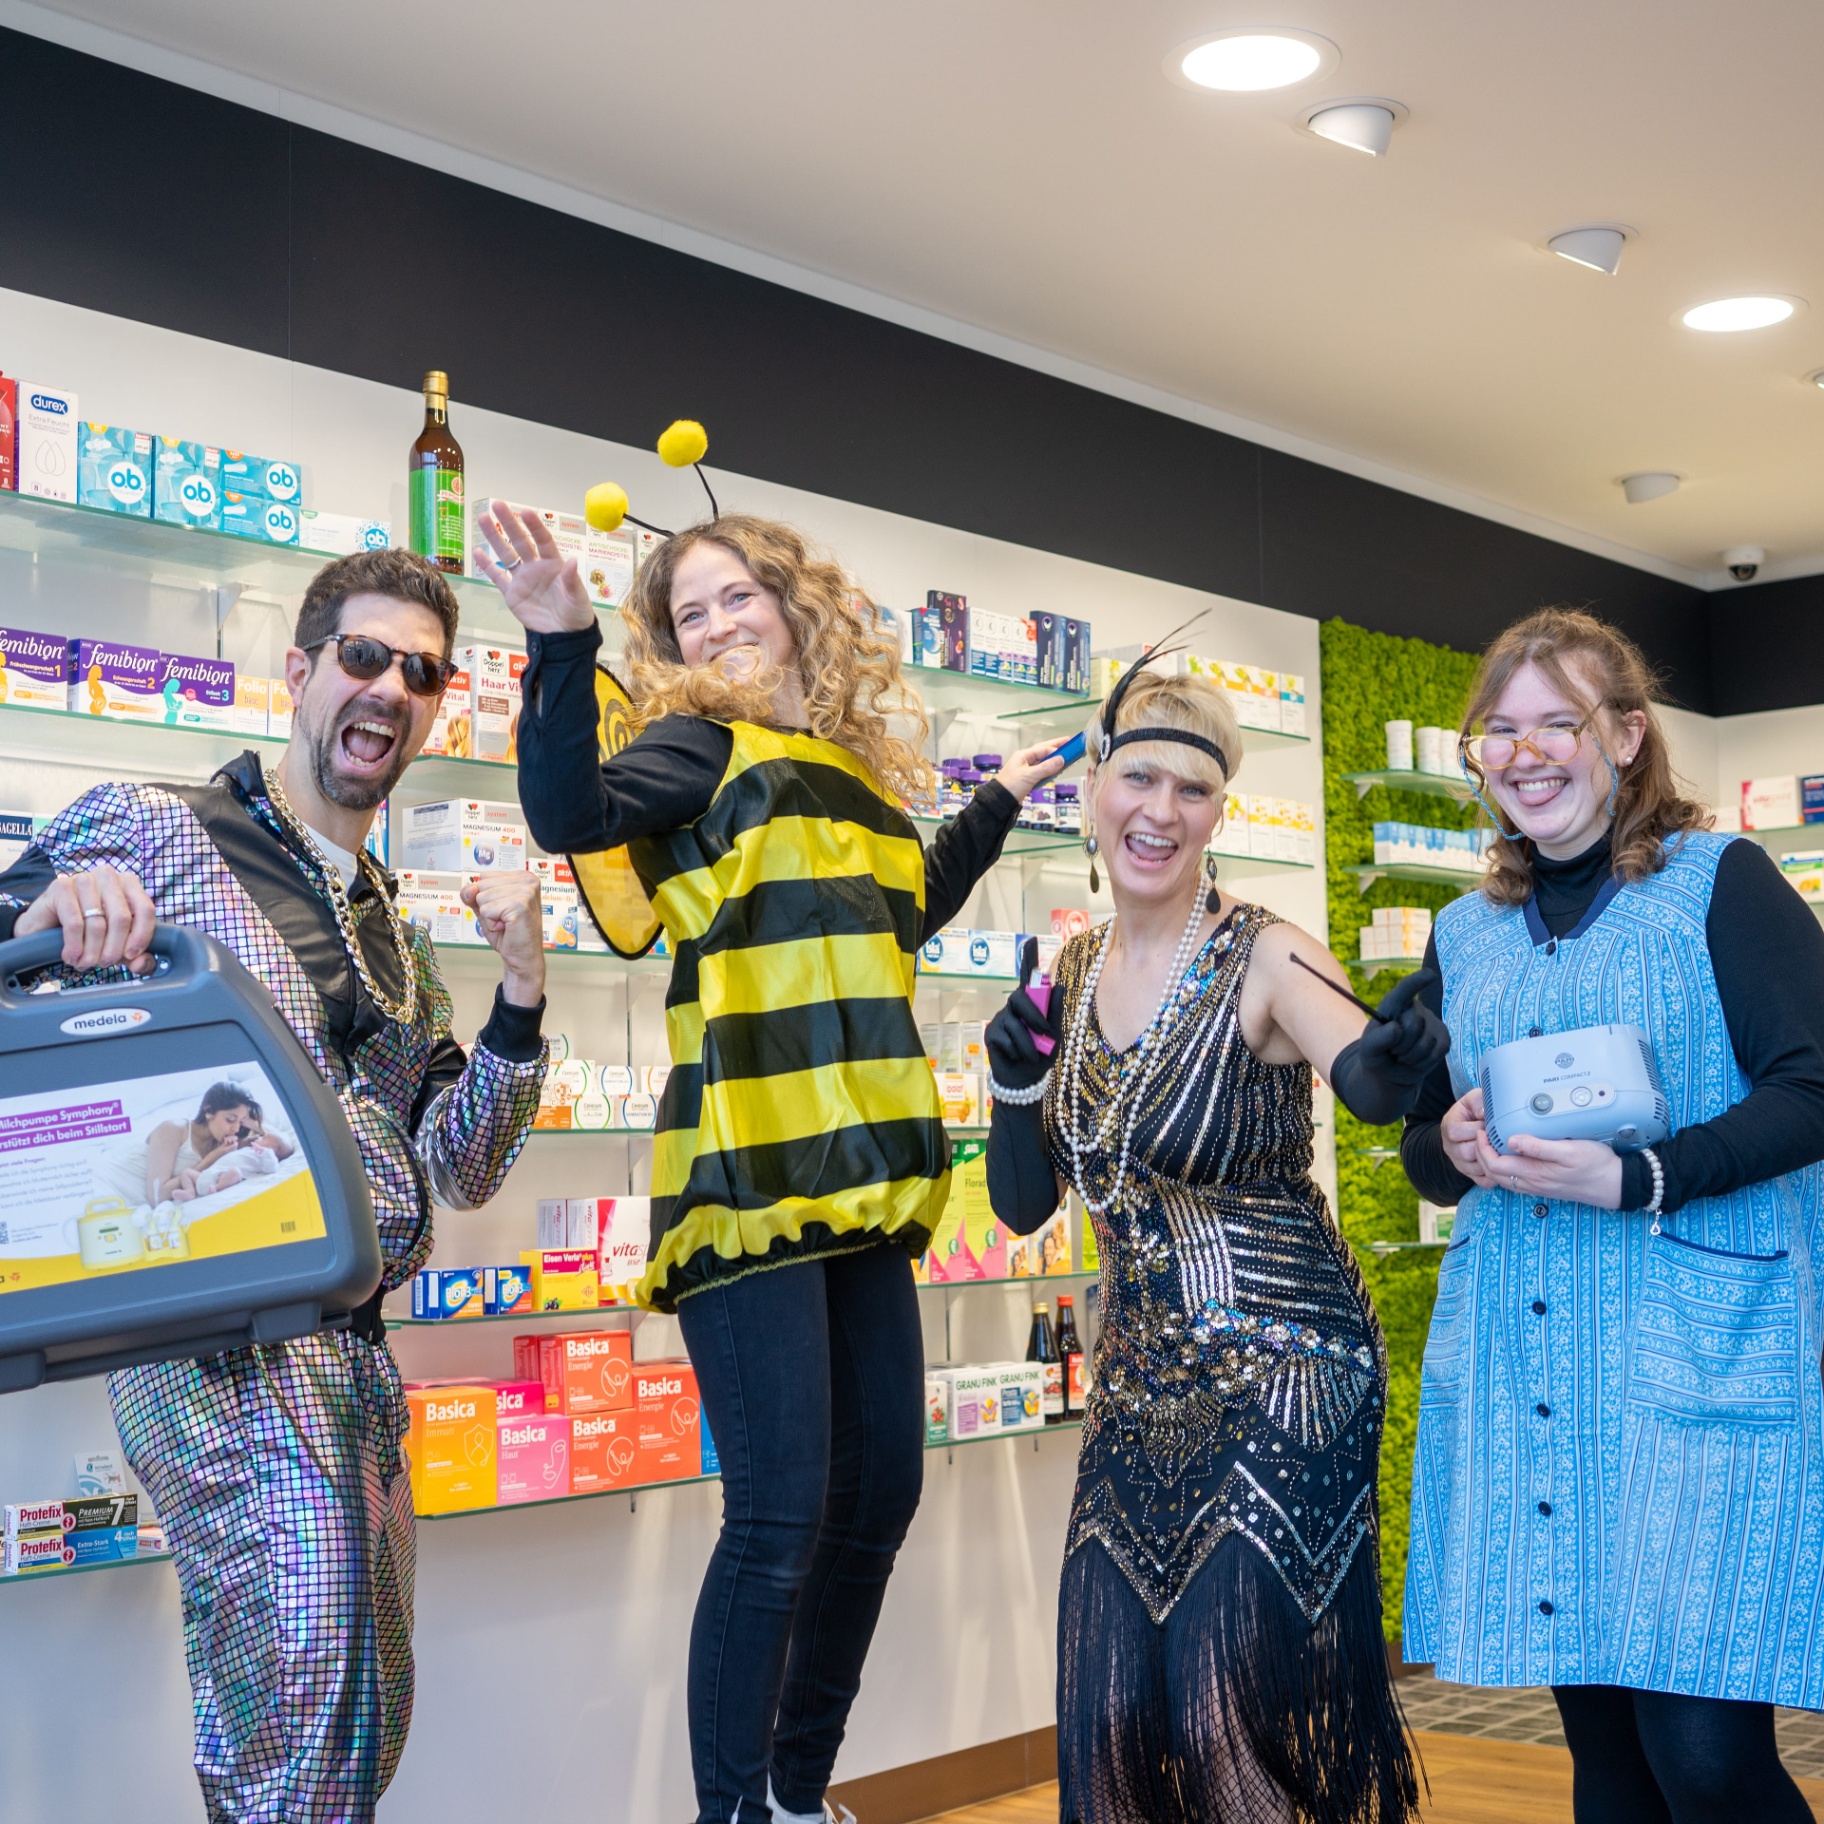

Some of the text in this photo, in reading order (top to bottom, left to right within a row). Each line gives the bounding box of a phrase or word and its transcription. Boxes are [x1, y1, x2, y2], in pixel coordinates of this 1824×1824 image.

[33, 396, 66, 414] durex
[82, 644, 156, 673] femibion
[484, 659, 504, 668] Doppel
[55, 665, 61, 677] 1
[161, 657, 230, 686] femibion
[488, 665, 500, 673] herz
[147, 677, 155, 689] 2
[237, 679, 266, 694] Folio
[482, 678, 522, 692] Haar Vit
[222, 690, 229, 701] 3
[446, 691, 465, 701] Vital
[540, 885, 575, 893] agnesium
[74, 1014, 127, 1030] medela
[33, 1132, 55, 1144] dich
[57, 1129, 83, 1141] beim
[85, 1122, 127, 1136] Stillstart
[544, 1254, 562, 1263] Eisen
[582, 1253, 594, 1261] plus
[567, 1338, 608, 1357] Basica
[568, 1361, 593, 1372] Energie
[956, 1376, 997, 1390] GRANU FINK
[1000, 1371, 1041, 1385] GRANU FINK
[638, 1377, 682, 1398] Basica
[496, 1391, 523, 1411] sica
[639, 1402, 664, 1412] Energie
[426, 1399, 476, 1422] Basica
[426, 1428, 455, 1438] Immun
[573, 1417, 616, 1437] Basica
[501, 1425, 547, 1446] Basica
[573, 1441, 599, 1451] Energie
[501, 1450, 519, 1460] Haut
[20, 1505, 61, 1522] Protefix
[79, 1498, 125, 1526] PREMIUM 7
[115, 1530, 122, 1542] 4
[21, 1539, 62, 1556] Protefix
[78, 1540, 108, 1549] Extra-Stark
